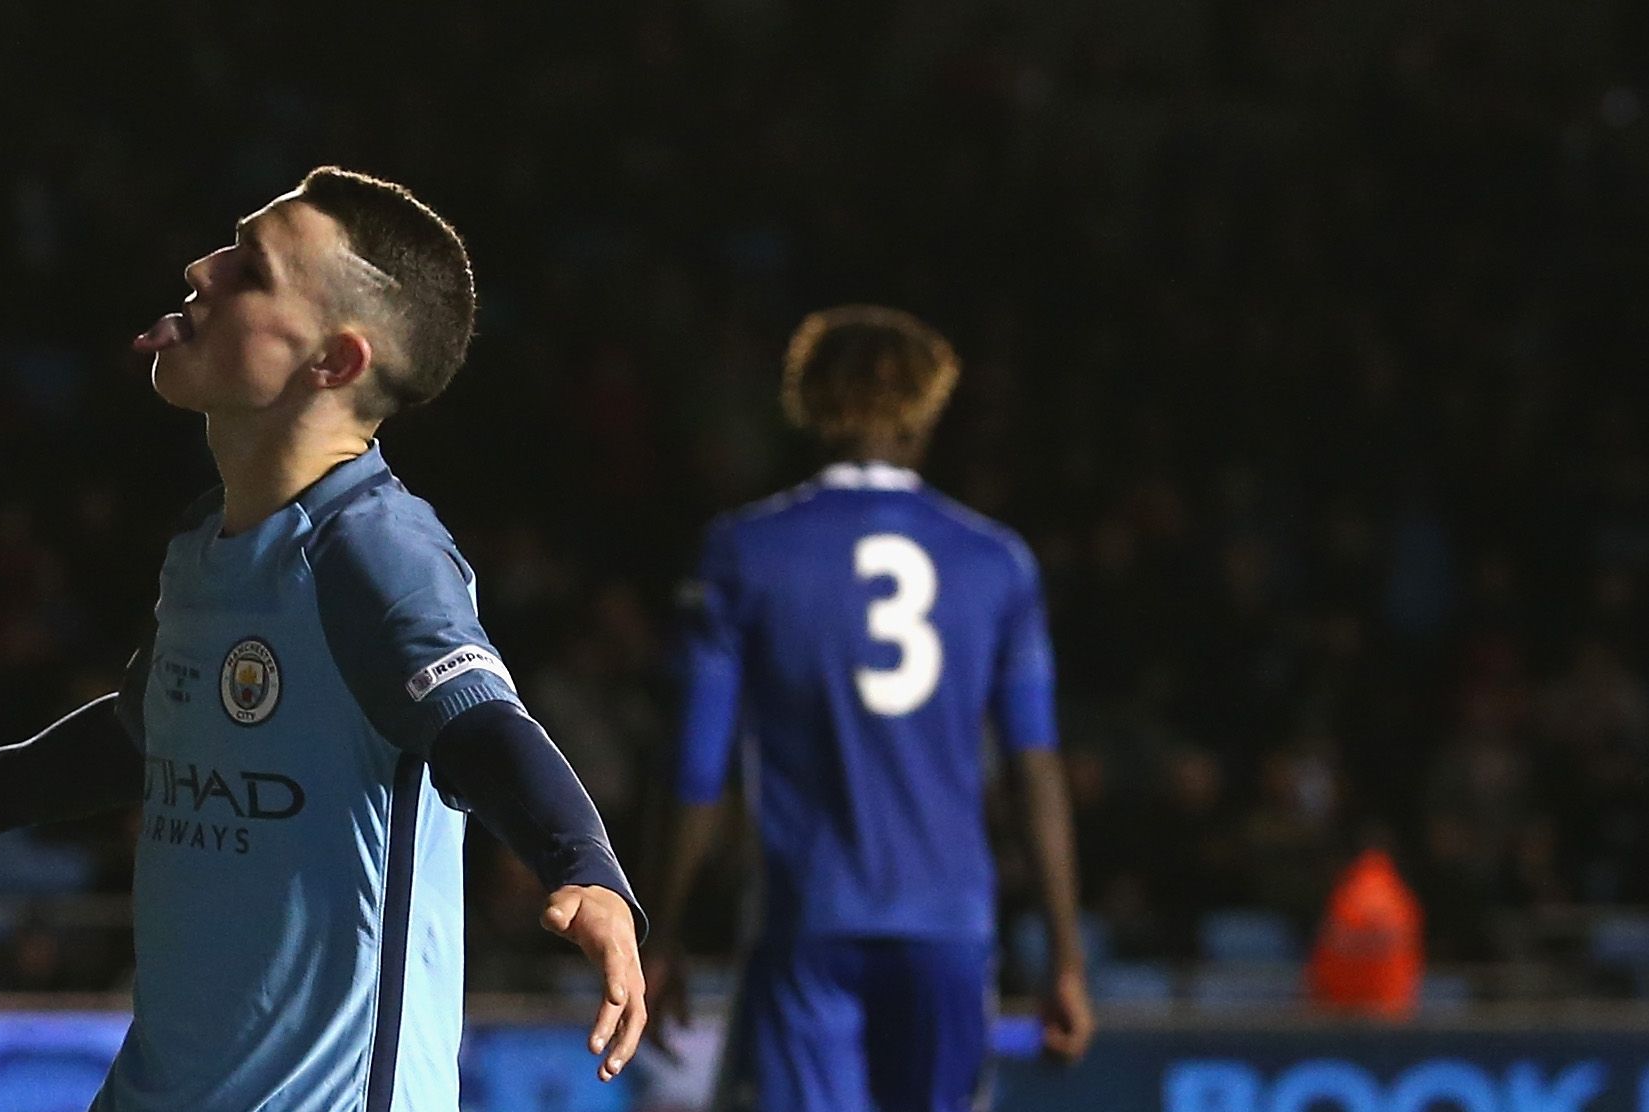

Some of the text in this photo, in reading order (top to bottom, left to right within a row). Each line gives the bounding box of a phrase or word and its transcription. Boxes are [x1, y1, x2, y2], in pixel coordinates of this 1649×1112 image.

[854, 533, 943, 717] 3
[235, 710, 256, 721] CITY
[146, 815, 250, 854] RWAYS
